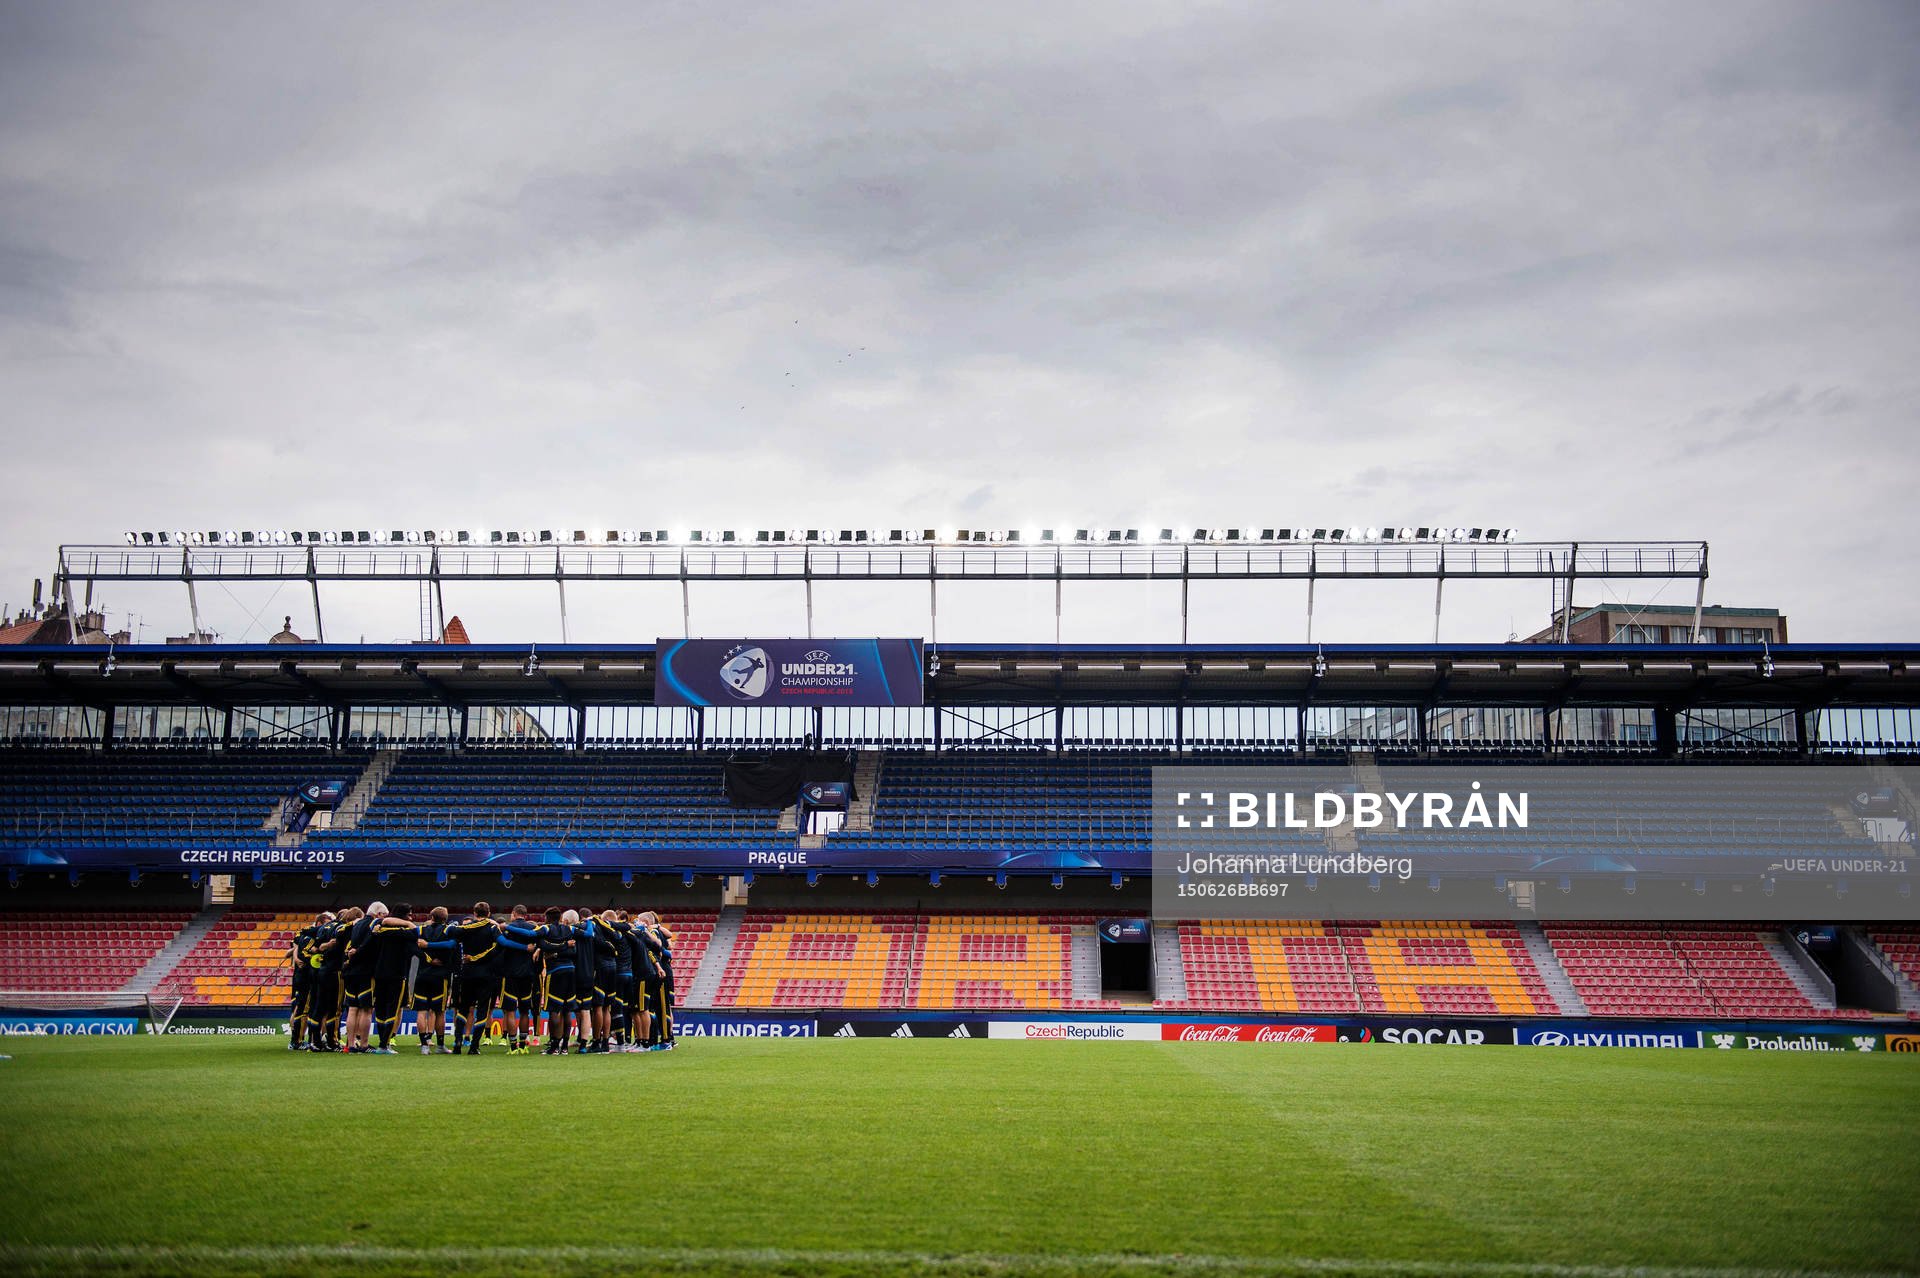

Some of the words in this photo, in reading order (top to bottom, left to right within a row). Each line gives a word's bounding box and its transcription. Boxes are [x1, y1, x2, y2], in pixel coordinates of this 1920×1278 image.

[805, 652, 829, 662] UEFA
[781, 663, 854, 675] UNDER21
[781, 677, 853, 686] CHAMPIONSHIP
[180, 850, 228, 863] CZECH
[232, 851, 302, 863] REPUBLIC
[307, 851, 345, 863] 2015
[748, 852, 806, 864] PRAGUE
[1784, 859, 1827, 872] UEFA
[63, 1023, 133, 1035] RACISM
[168, 1025, 214, 1035] Celebrate
[217, 1025, 276, 1035] Responsibly
[672, 1023, 705, 1036] EFA
[788, 1024, 809, 1036] 21
[1382, 1028, 1484, 1045] SOCAR
